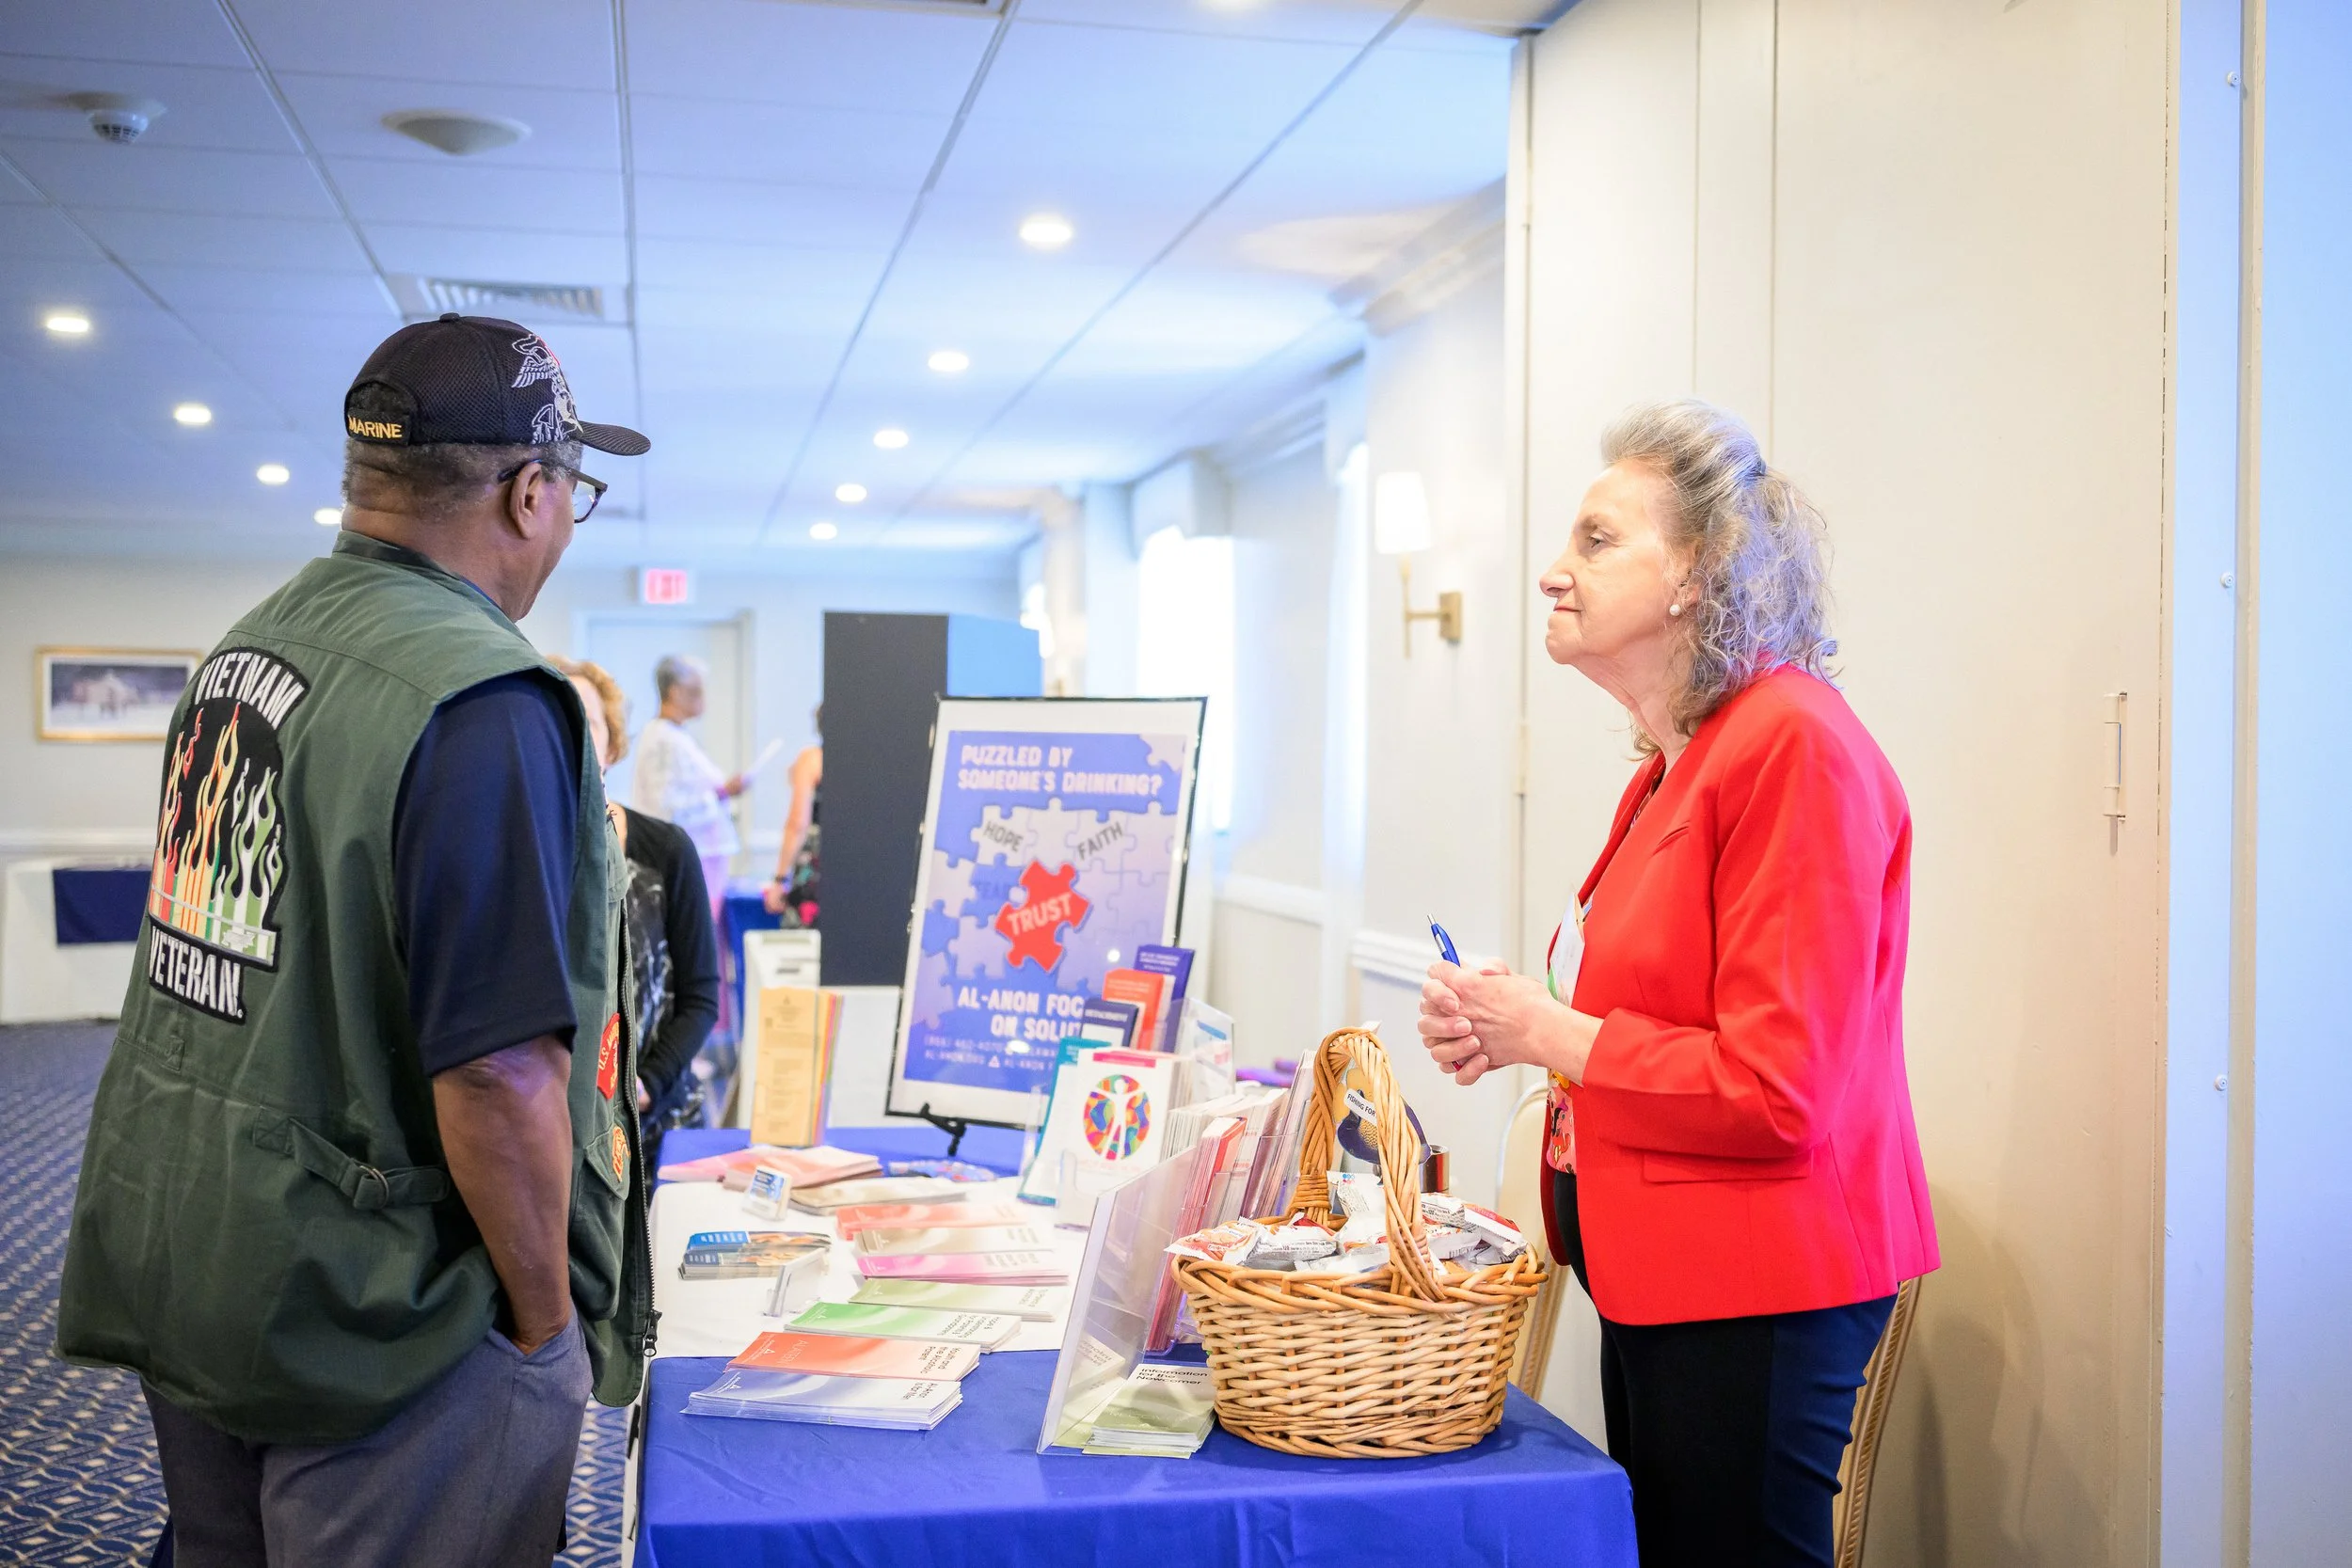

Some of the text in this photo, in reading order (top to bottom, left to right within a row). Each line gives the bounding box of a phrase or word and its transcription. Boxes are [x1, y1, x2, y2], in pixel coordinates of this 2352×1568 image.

[347, 415, 403, 439] MARINE
[194, 652, 305, 731] VIETNAM
[961, 744, 1073, 768] PUZZLED BY
[958, 768, 1163, 796] SOMEONE'S DRINKING?
[983, 820, 1024, 852] HOPE
[1077, 821, 1123, 861] FAITH
[1007, 892, 1072, 936] TRUST
[958, 986, 1040, 1015] AL-ANON
[1046, 993, 1085, 1019] FOC
[991, 1014, 1081, 1043] ON SOLU
[1347, 1094, 1376, 1117] FISHING FOR
[938, 1347, 961, 1370] Youth and
[1141, 1368, 1208, 1377] Information
[1136, 1376, 1202, 1385] Newcomer
